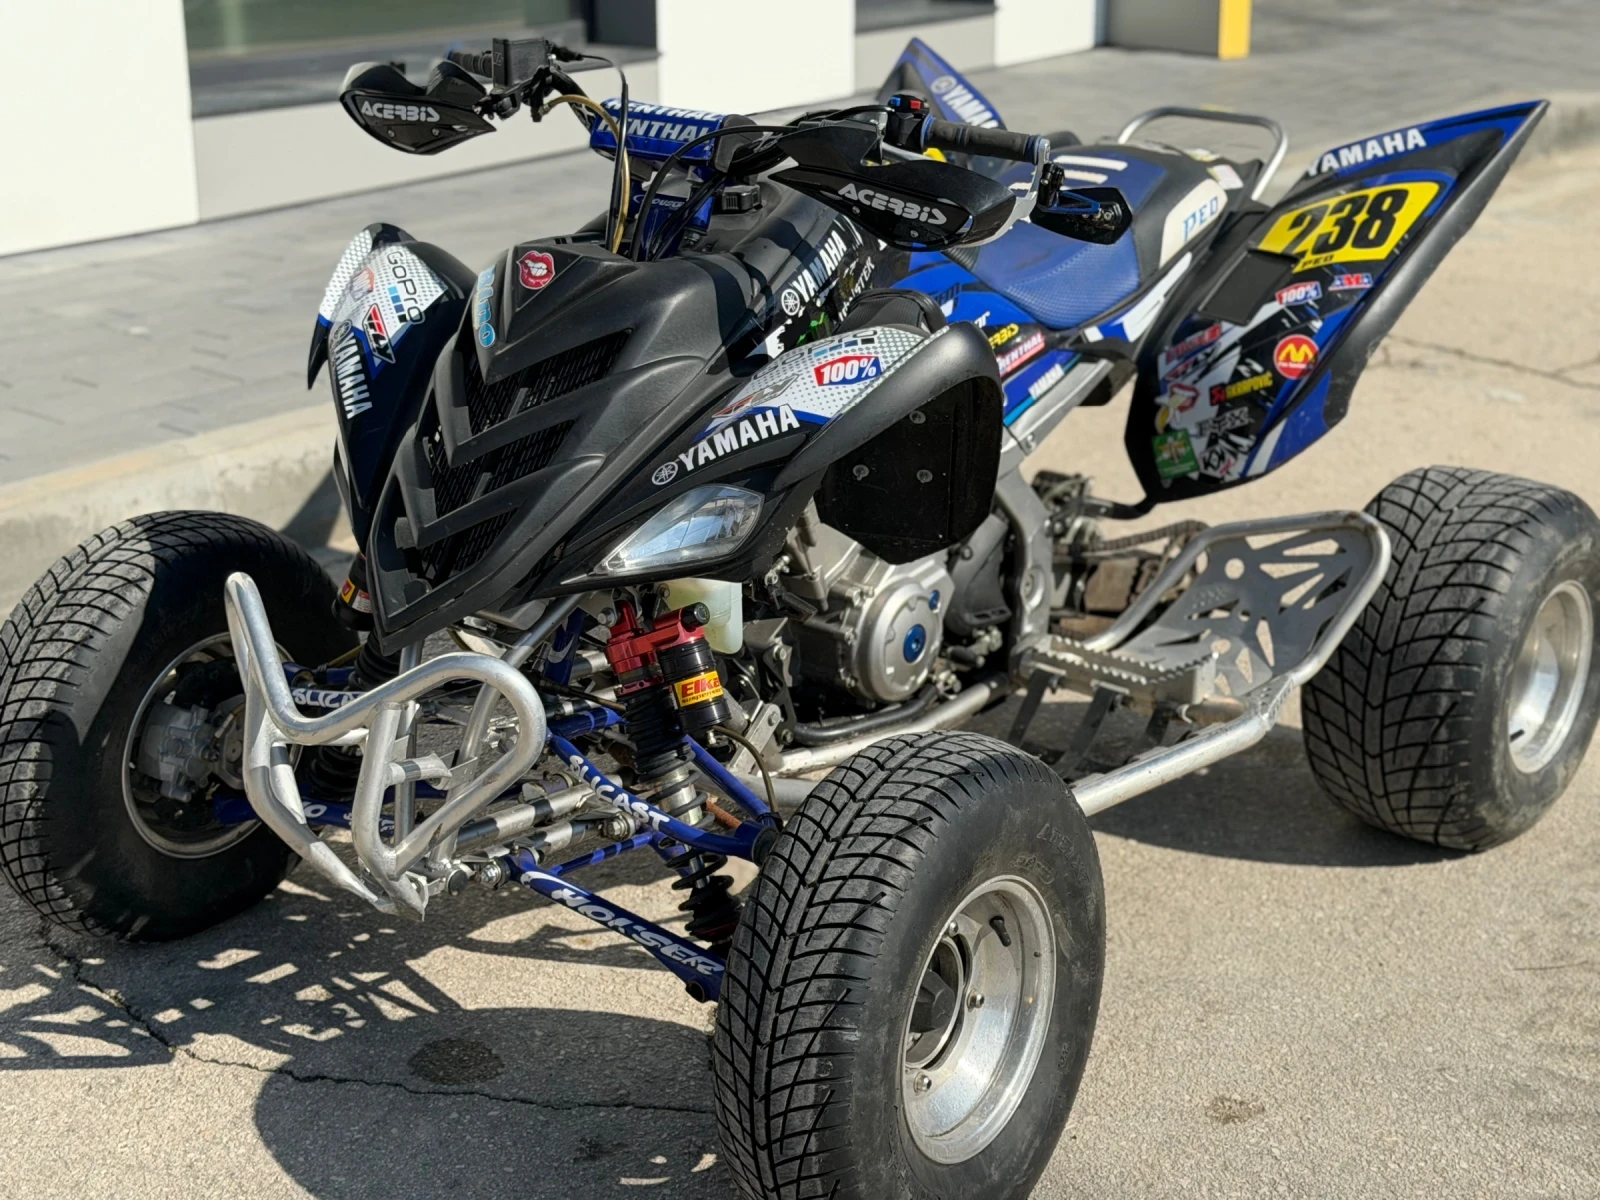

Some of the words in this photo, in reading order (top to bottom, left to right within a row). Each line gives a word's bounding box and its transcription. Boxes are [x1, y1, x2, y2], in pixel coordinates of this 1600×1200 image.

[360, 101, 440, 122] ACERBIS
[1305, 128, 1426, 176] YAMAHA
[837, 183, 948, 226] ACERBIS
[1287, 188, 1409, 257] 238
[792, 230, 847, 303] YAMAHA
[1281, 283, 1318, 304] 100%
[333, 331, 373, 420] YAMAHA
[819, 357, 877, 385] 100%
[677, 402, 801, 472] YAMAHA
[681, 676, 722, 699] Elka
